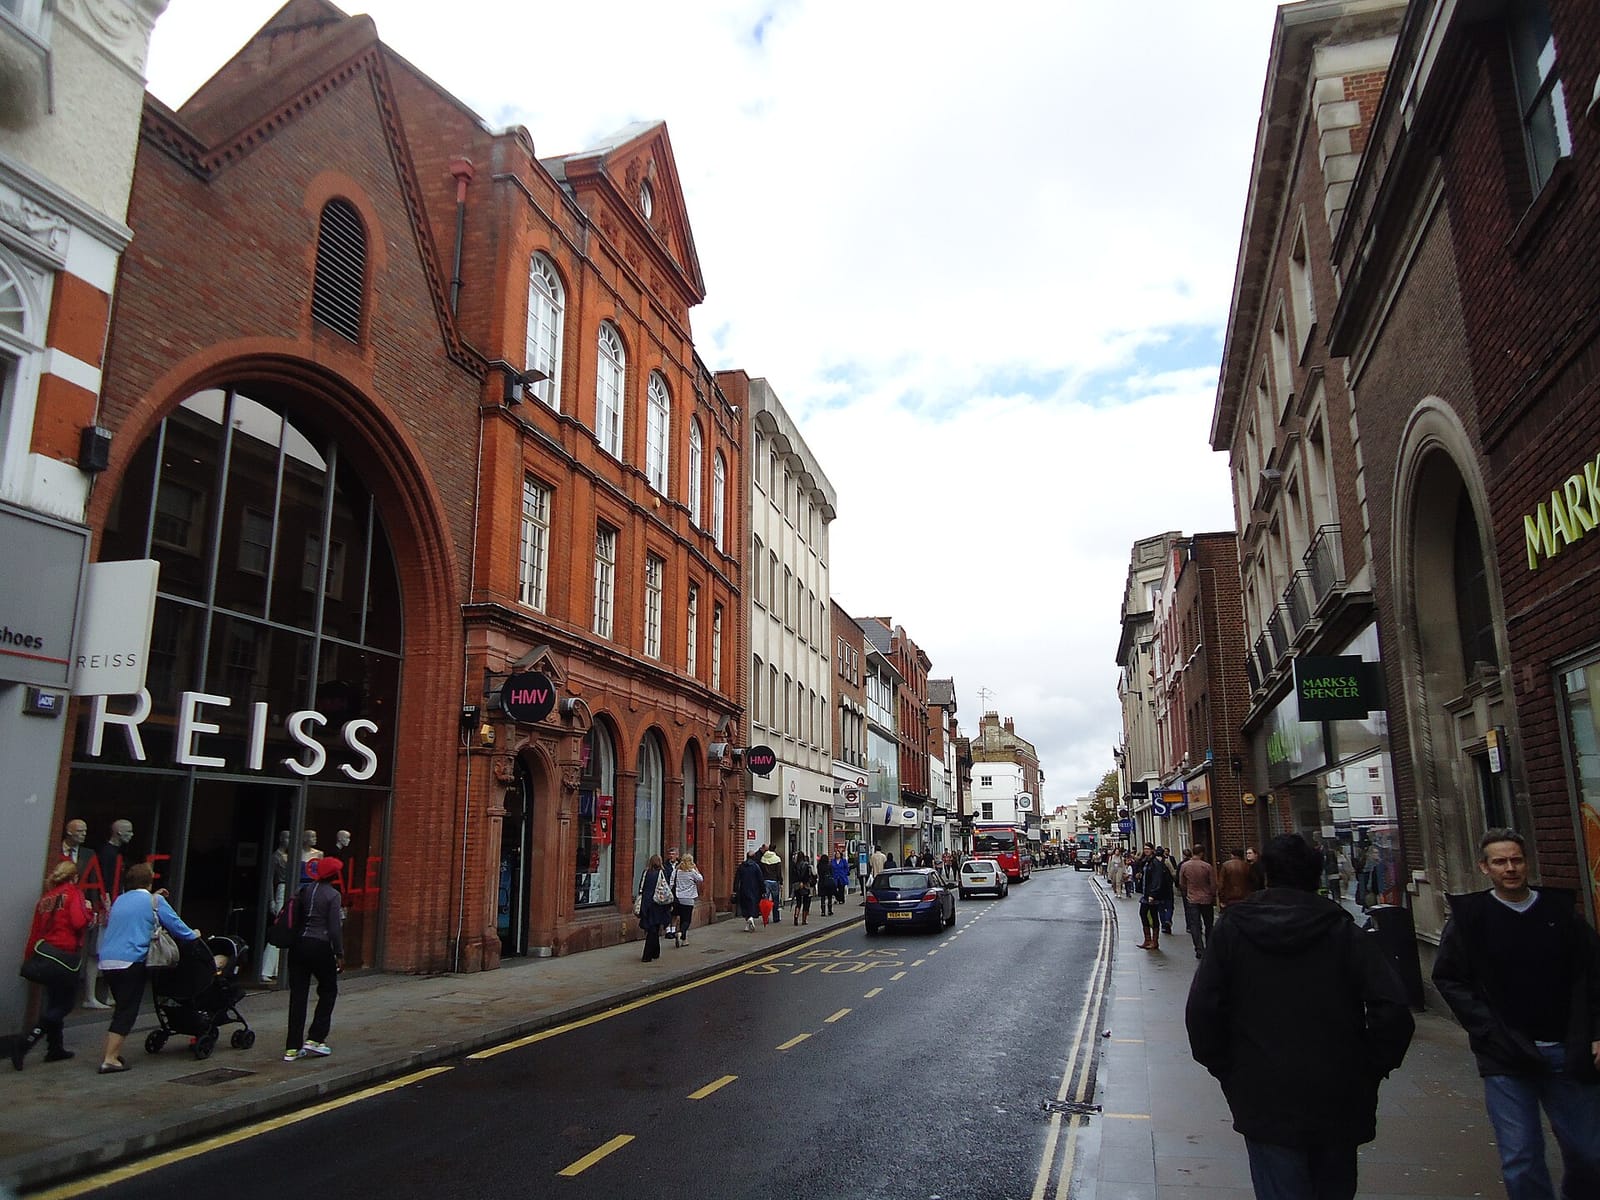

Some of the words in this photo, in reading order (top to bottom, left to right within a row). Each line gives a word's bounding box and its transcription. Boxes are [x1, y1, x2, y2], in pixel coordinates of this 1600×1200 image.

[0, 626, 43, 649] hoes
[76, 653, 137, 669] REISS
[1302, 676, 1347, 688] MARKS
[1347, 676, 1358, 687] &
[511, 688, 549, 705] HMV
[1302, 687, 1360, 699] SPENCER
[86, 685, 379, 781] REISS
[749, 755, 773, 765] HMV
[797, 948, 907, 959] BUS
[744, 960, 905, 975] STOP
